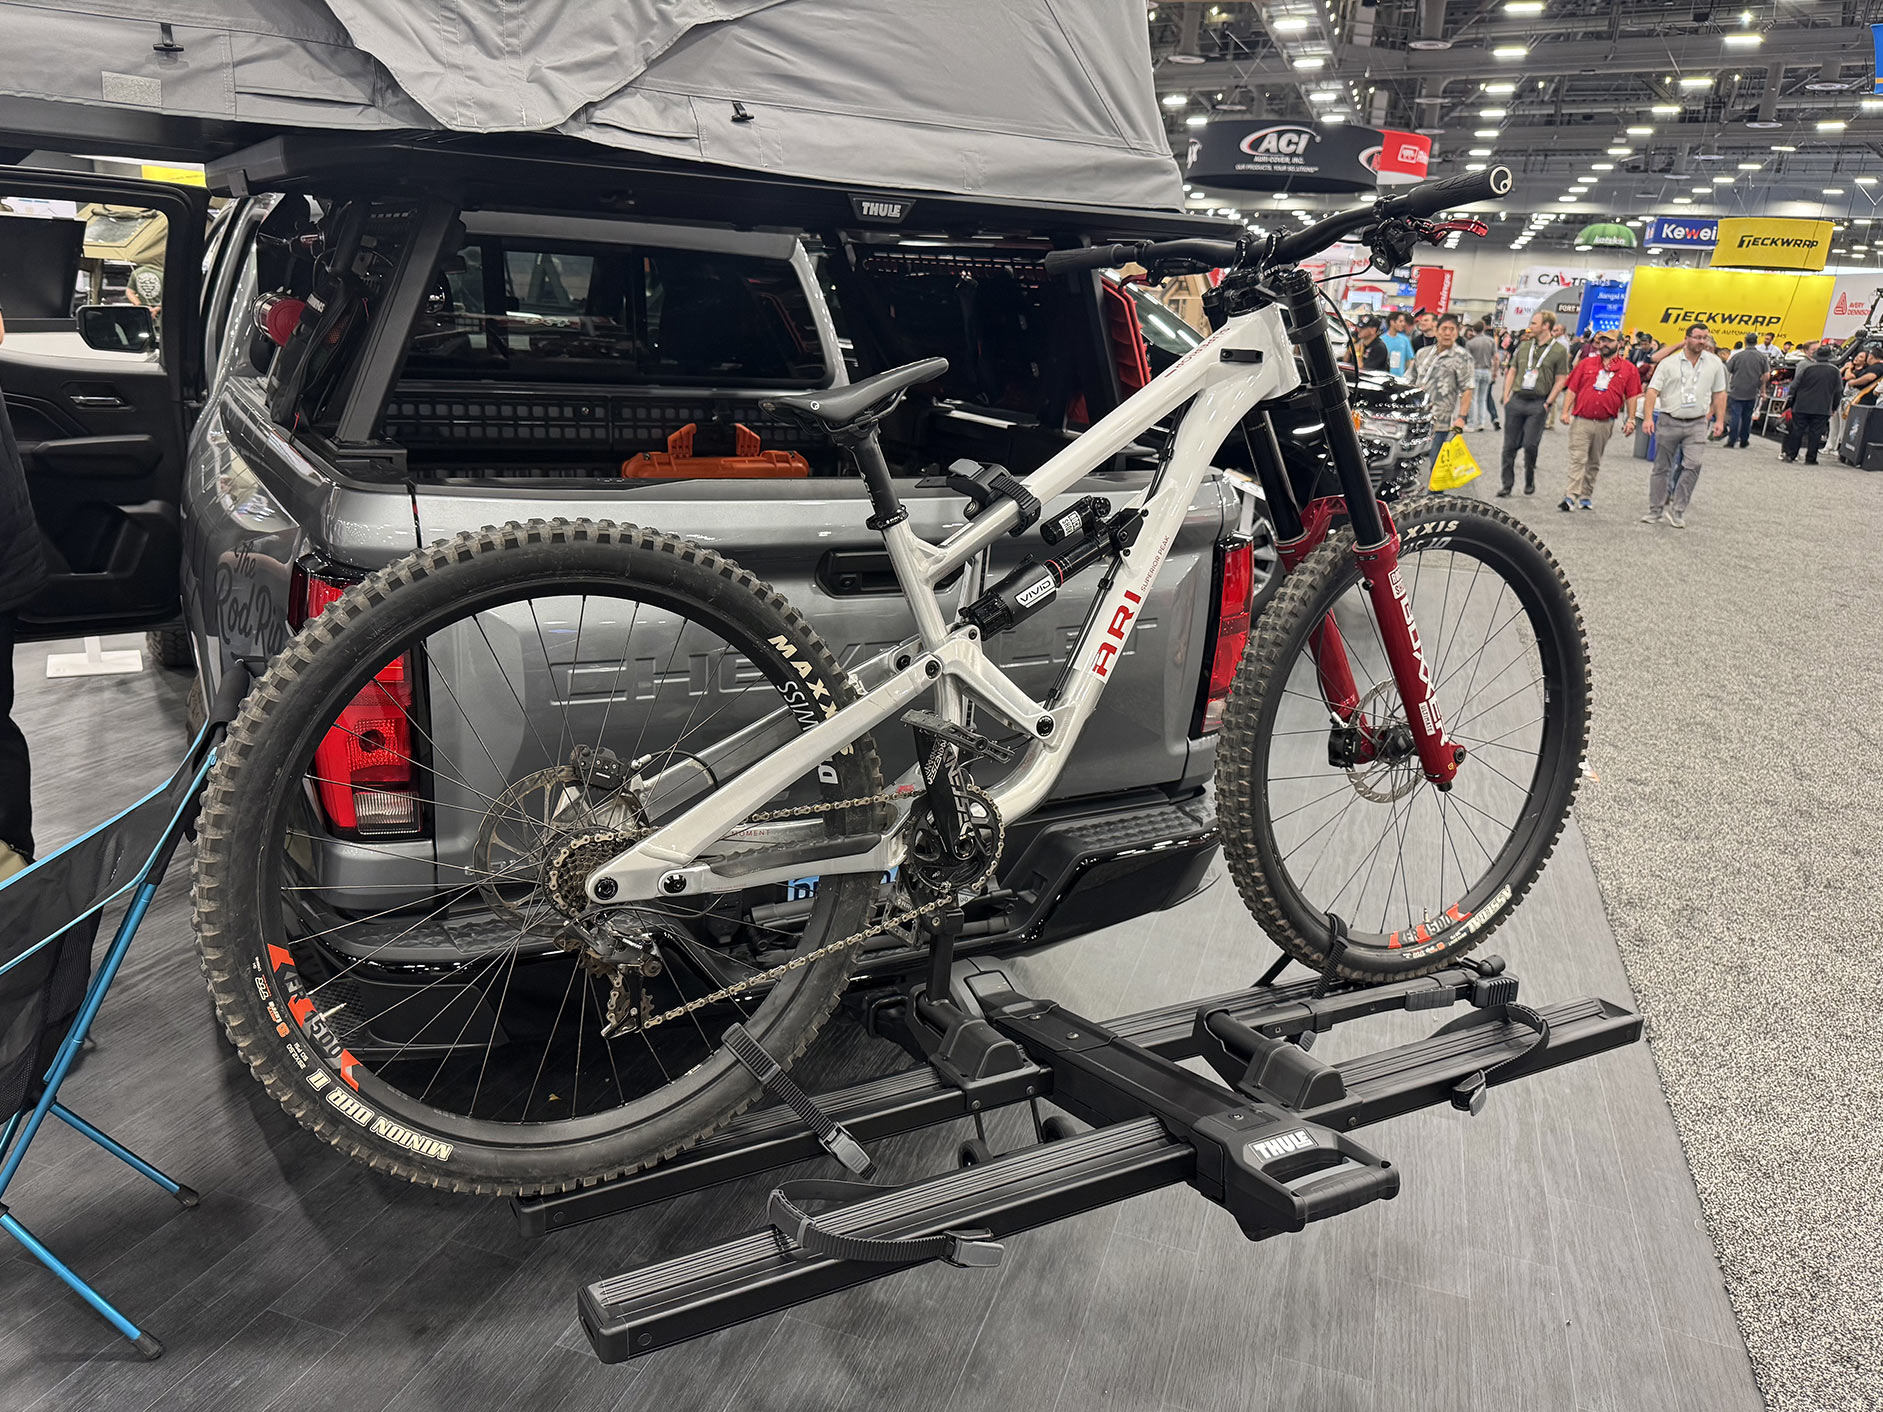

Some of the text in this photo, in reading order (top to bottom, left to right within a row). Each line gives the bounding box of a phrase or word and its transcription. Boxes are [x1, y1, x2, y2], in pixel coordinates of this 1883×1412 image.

[1257, 132, 1310, 155] ACI
[862, 201, 902, 218] THULE
[1662, 223, 1718, 242] Kewei
[1737, 235, 1819, 249] TECKWRAP
[1660, 307, 1782, 327] TECKWRAP
[1396, 520, 1460, 544] XXIS
[233, 540, 256, 579] The
[1140, 535, 1171, 592] SUPERIOR PEAK
[1019, 579, 1052, 603] VIVID
[1092, 590, 1142, 677] ARI
[1400, 594, 1450, 747] BOXXER
[767, 634, 854, 757] MAXXS
[1420, 702, 1434, 734] ULTIMATE
[731, 829, 771, 837] MOMENT
[303, 1011, 343, 1058] 1500
[324, 1086, 376, 1128] DHR
[369, 1115, 455, 1162] MINION
[1252, 1130, 1315, 1160] THULE
